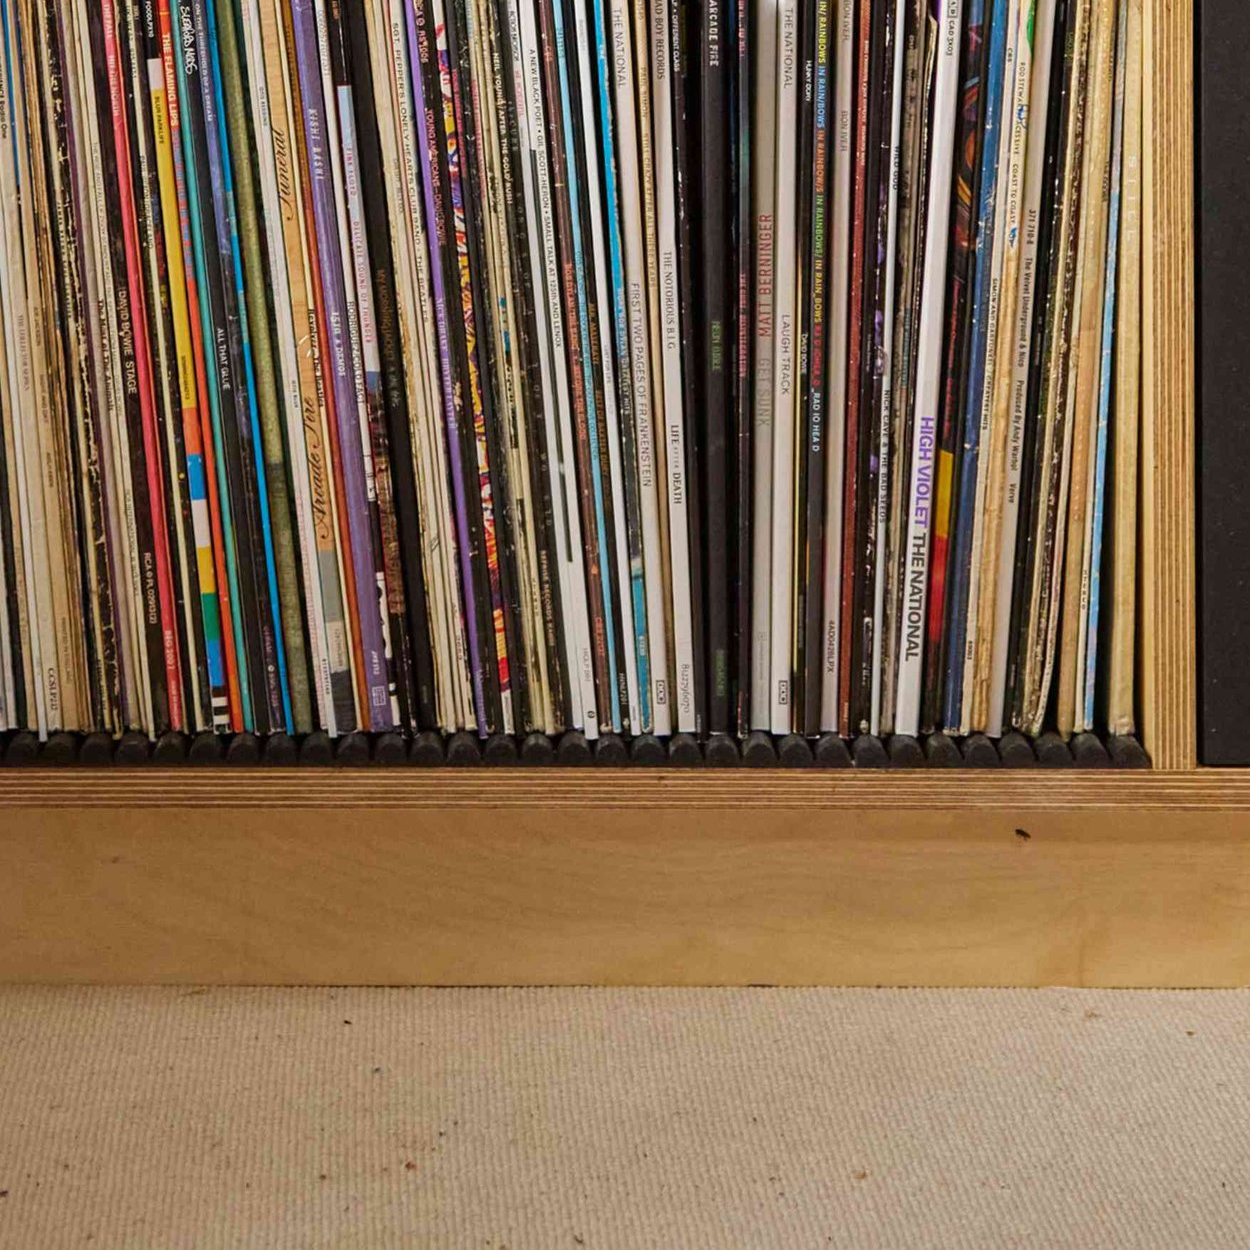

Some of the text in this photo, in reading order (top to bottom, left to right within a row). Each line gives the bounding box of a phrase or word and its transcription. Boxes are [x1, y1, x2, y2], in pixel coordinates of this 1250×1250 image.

[194, 3, 201, 13] ON
[655, 18, 664, 37] BOY
[671, 15, 679, 50] DIFFERENT
[708, 0, 719, 67] ARCADE FIRE
[817, 17, 826, 64] RAINBOWS
[947, 20, 955, 36] CAD
[197, 31, 207, 76] THRESHOLD
[529, 56, 537, 74] NEW
[655, 38, 665, 80] RECORDS
[162, 32, 179, 126] THE FLAMING LIPS
[395, 49, 406, 99] PEPPER'S
[818, 65, 826, 76] IN
[839, 0, 851, 152] BON BON IVER
[154, 96, 162, 112] BLUR
[531, 77, 540, 104] BLACK
[804, 84, 812, 102] DORY
[816, 78, 825, 127] RAIN/BOWS
[204, 95, 213, 122] DREAM
[399, 101, 410, 141] LONELY
[533, 106, 542, 127] POET
[156, 114, 165, 145] PARKLIFE
[426, 108, 435, 138] YOUNG
[492, 52, 513, 205] NEIL THE GOLD RUSH
[817, 130, 825, 139] IN
[308, 108, 323, 180] KISHI BASHI
[537, 135, 545, 148] GIL
[403, 143, 414, 185] HEARTS
[816, 141, 825, 192] RAINBOW/S
[1011, 164, 1019, 187] COAST
[537, 150, 549, 209] SCOTT-HERON
[408, 187, 417, 214] CLUB
[781, 8, 793, 395] THE NATIONAL LAUGH TRACK
[816, 194, 825, 205] IN
[411, 217, 421, 245] BAND
[543, 216, 553, 244] SMALL
[815, 207, 824, 258] RAINBOWS/
[546, 246, 555, 266] TALK
[613, 8, 651, 487] THE NATIONAL FIRST TWO PAGES OF FRANKENSTEIN
[663, 251, 673, 270] THE
[357, 262, 367, 290] SOUND
[416, 255, 425, 274] THE
[548, 267, 556, 278] AT
[758, 214, 772, 338] MATT BERNINGER
[815, 259, 823, 270] IN
[1024, 258, 1033, 269] The
[813, 272, 823, 322] RAIN_BOWS
[1022, 272, 1032, 294] Velvet
[97, 298, 105, 316] The
[360, 292, 369, 304] OF
[418, 278, 429, 324] BEATLES
[551, 302, 559, 319] AND
[664, 271, 675, 325] NOTORIOUS
[436, 297, 448, 351] NICK DRAKE
[711, 321, 721, 343] NEON
[1018, 296, 1030, 341] Underground
[552, 321, 562, 348] LENOX
[102, 355, 111, 372] The
[216, 327, 230, 390] ALL THAT GLUE
[307, 308, 324, 408] Revolver The Beatles
[1018, 351, 1026, 368] Nico
[104, 374, 115, 412] Animals
[757, 358, 771, 427] GET SUNK
[1014, 380, 1024, 413] Produced
[118, 290, 152, 571] DAVID BOWIE STAGE RCA
[881, 414, 889, 438] CAVE
[1012, 415, 1022, 424] By
[670, 424, 680, 444] LIFE
[1010, 425, 1021, 443] Andy
[1011, 445, 1020, 471] Warhol
[672, 472, 683, 504] DEATH
[1009, 483, 1017, 504] Verve
[904, 417, 935, 662] HIGH VIOLET THE NATIONAL
[543, 583, 553, 621] RECORDS
